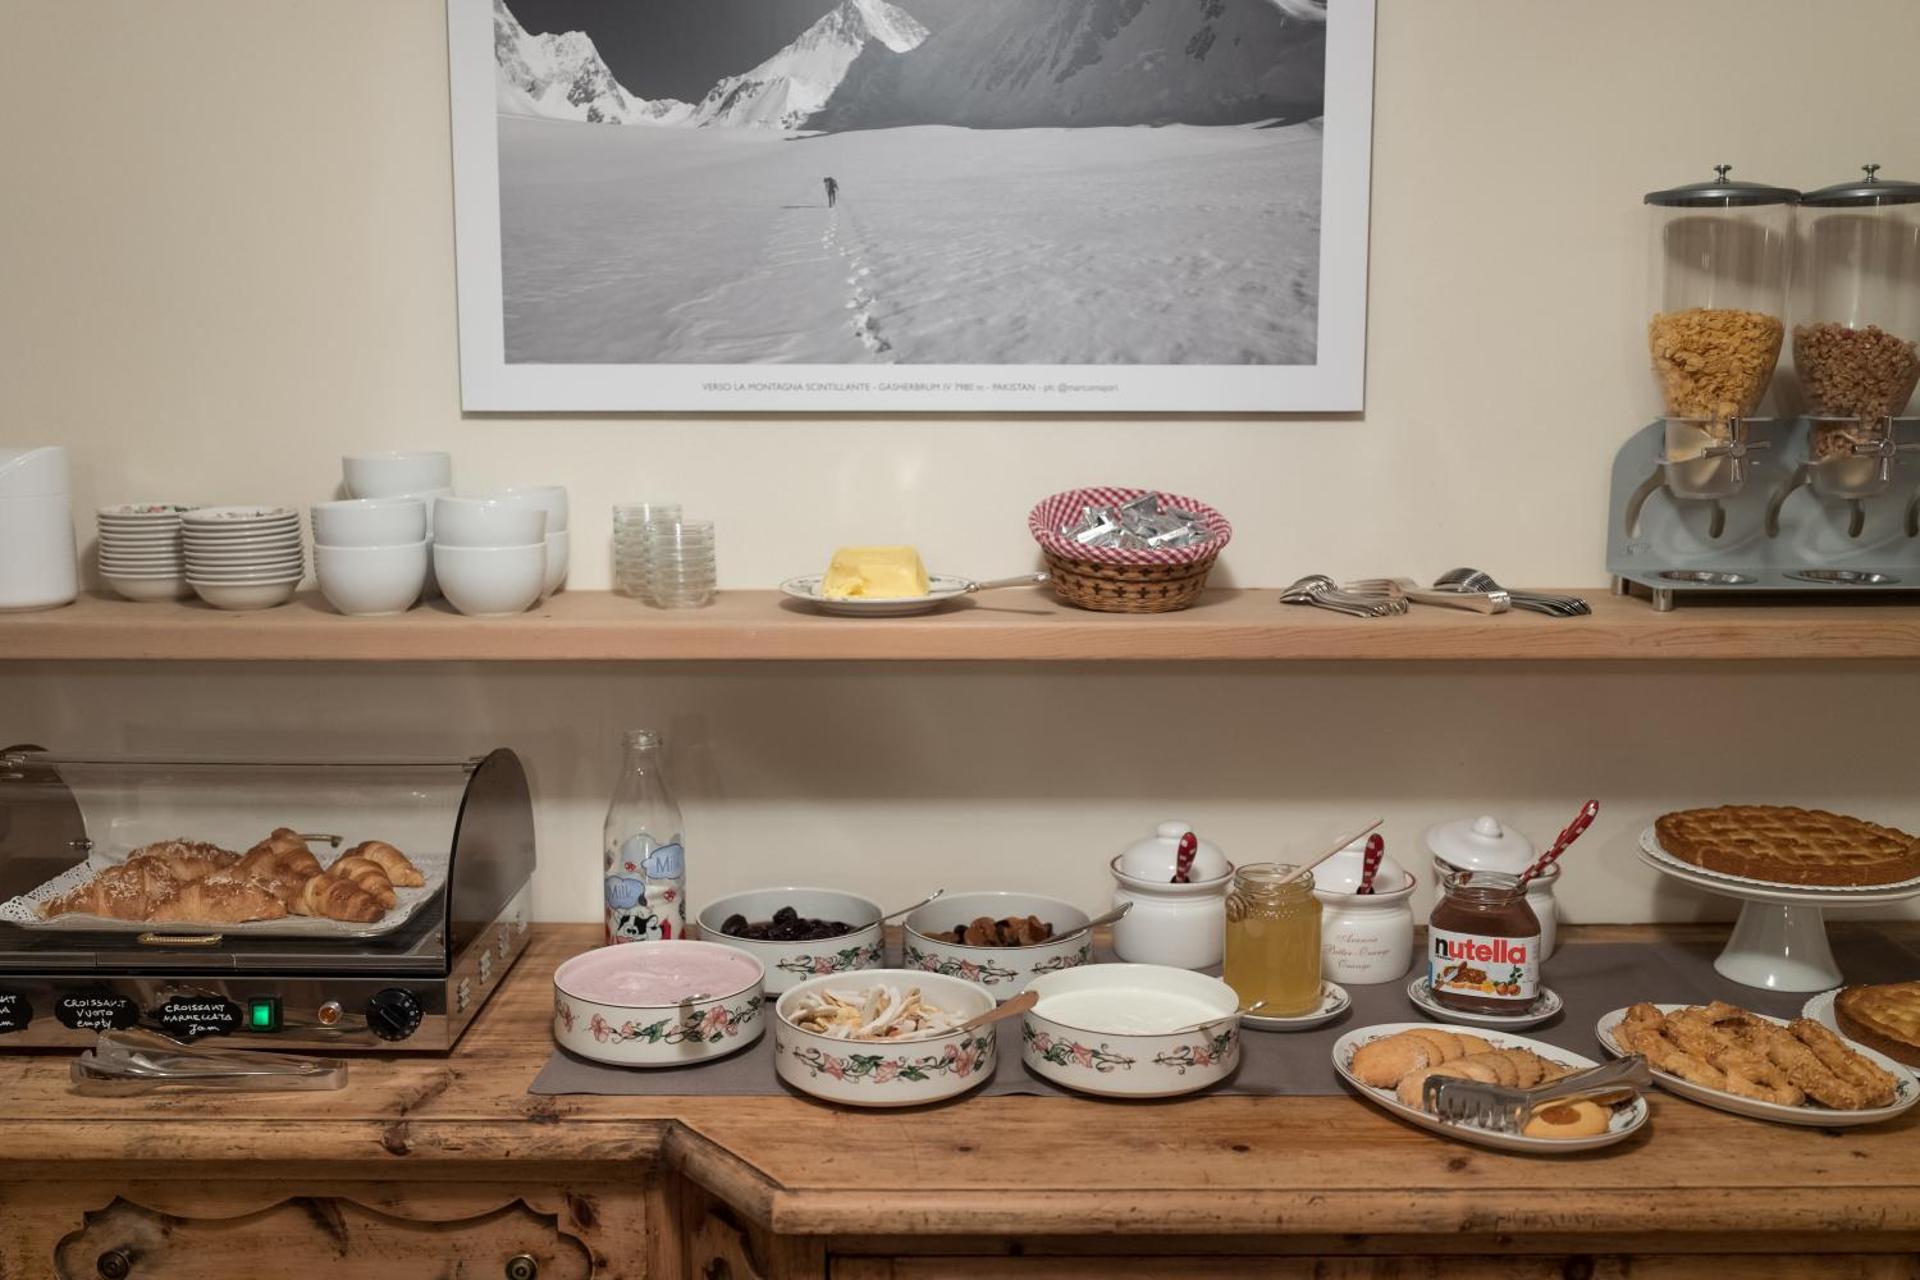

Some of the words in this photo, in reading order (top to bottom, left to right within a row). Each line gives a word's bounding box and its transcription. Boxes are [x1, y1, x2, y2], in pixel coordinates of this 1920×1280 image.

[702, 382, 732, 392] VERSO
[733, 382, 746, 392] LA
[748, 382, 803, 392] MONTAGNA
[804, 382, 870, 392] SCINTILLANTE
[878, 382, 940, 392] GASHERBRUM
[942, 382, 951, 392] IV
[992, 382, 1036, 392] PAKISTAN
[1435, 937, 1527, 965] nutella
[63, 999, 127, 1008] CROISSANT
[164, 1004, 226, 1013] CROISSANT
[76, 1008, 114, 1018] VUOTO
[163, 1013, 233, 1023] MARMELLATA
[76, 1018, 112, 1029] empty
